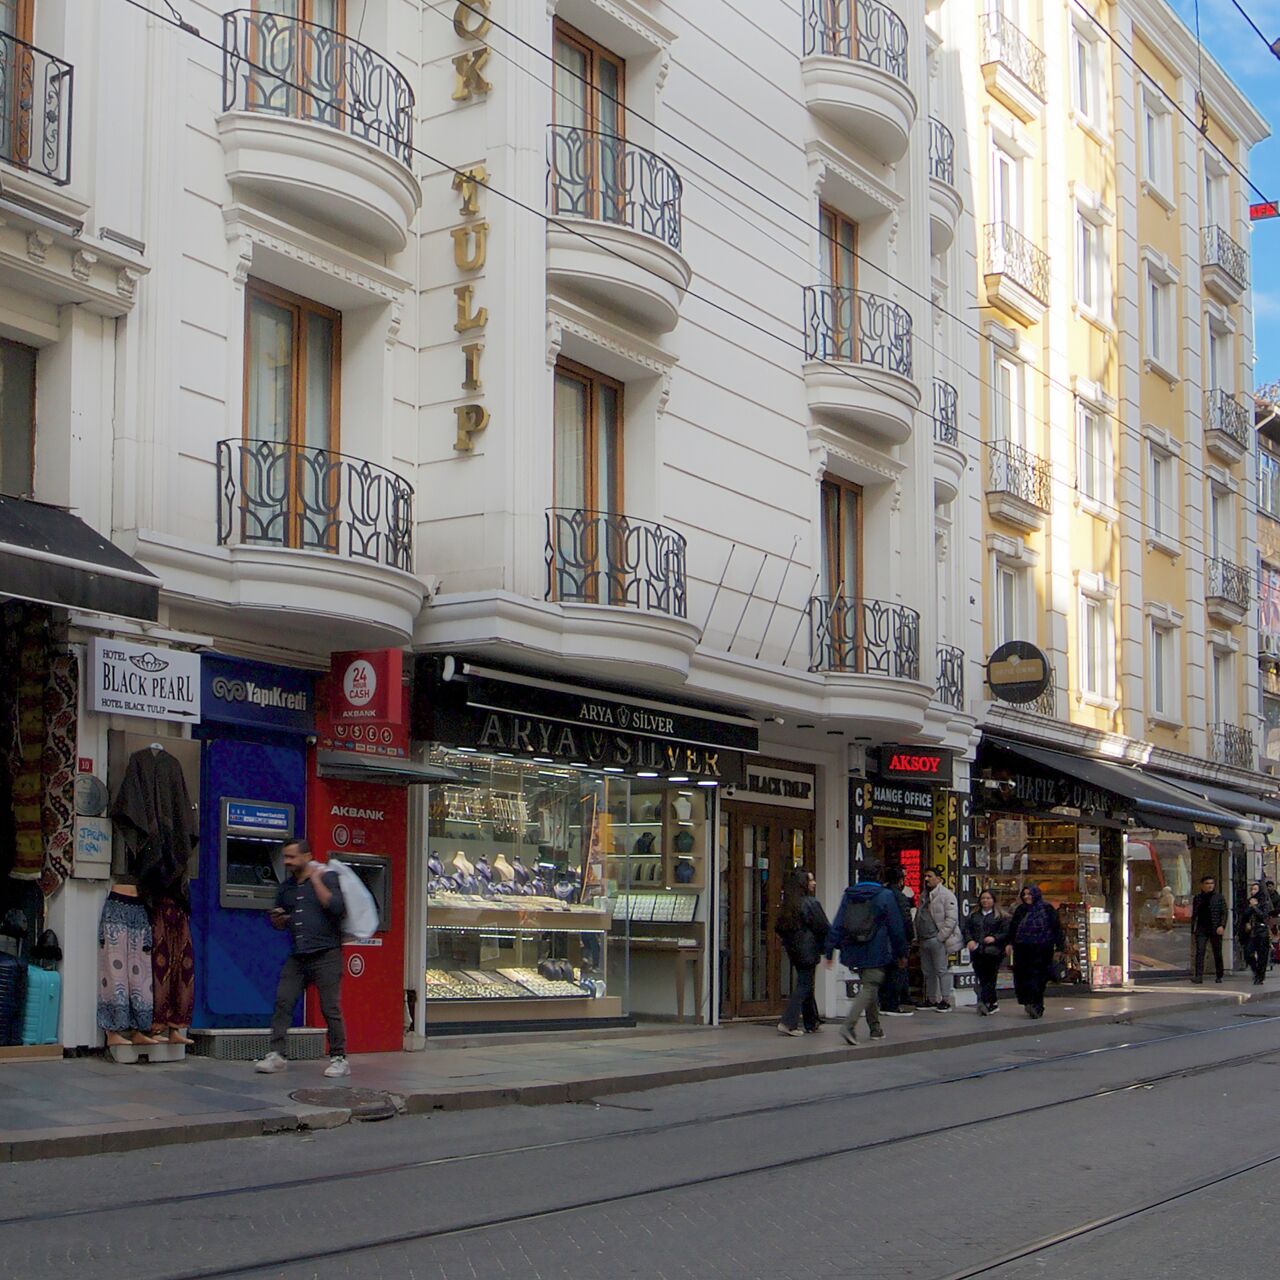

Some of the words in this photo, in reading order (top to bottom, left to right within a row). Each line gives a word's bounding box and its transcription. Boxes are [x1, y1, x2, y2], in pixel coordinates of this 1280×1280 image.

[450, 164, 492, 453] TULIP
[102, 648, 127, 662] HOTEL
[103, 662, 147, 696] BLACK
[152, 676, 194, 702] PEARL
[353, 667, 367, 681] 24
[246, 681, 307, 711] YapıKredi
[349, 689, 370, 699] CASH
[101, 698, 123, 709] HOTEL
[124, 701, 145, 712] BLACK
[147, 704, 167, 715] TULIP
[342, 709, 376, 718] AKBANK
[579, 703, 614, 724] ARYA
[632, 711, 675, 734] SİLVER
[478, 713, 579, 757] ARYA
[888, 753, 941, 773] AKSOY
[904, 791, 932, 807] OFFICE
[331, 805, 385, 821] AKBANK
